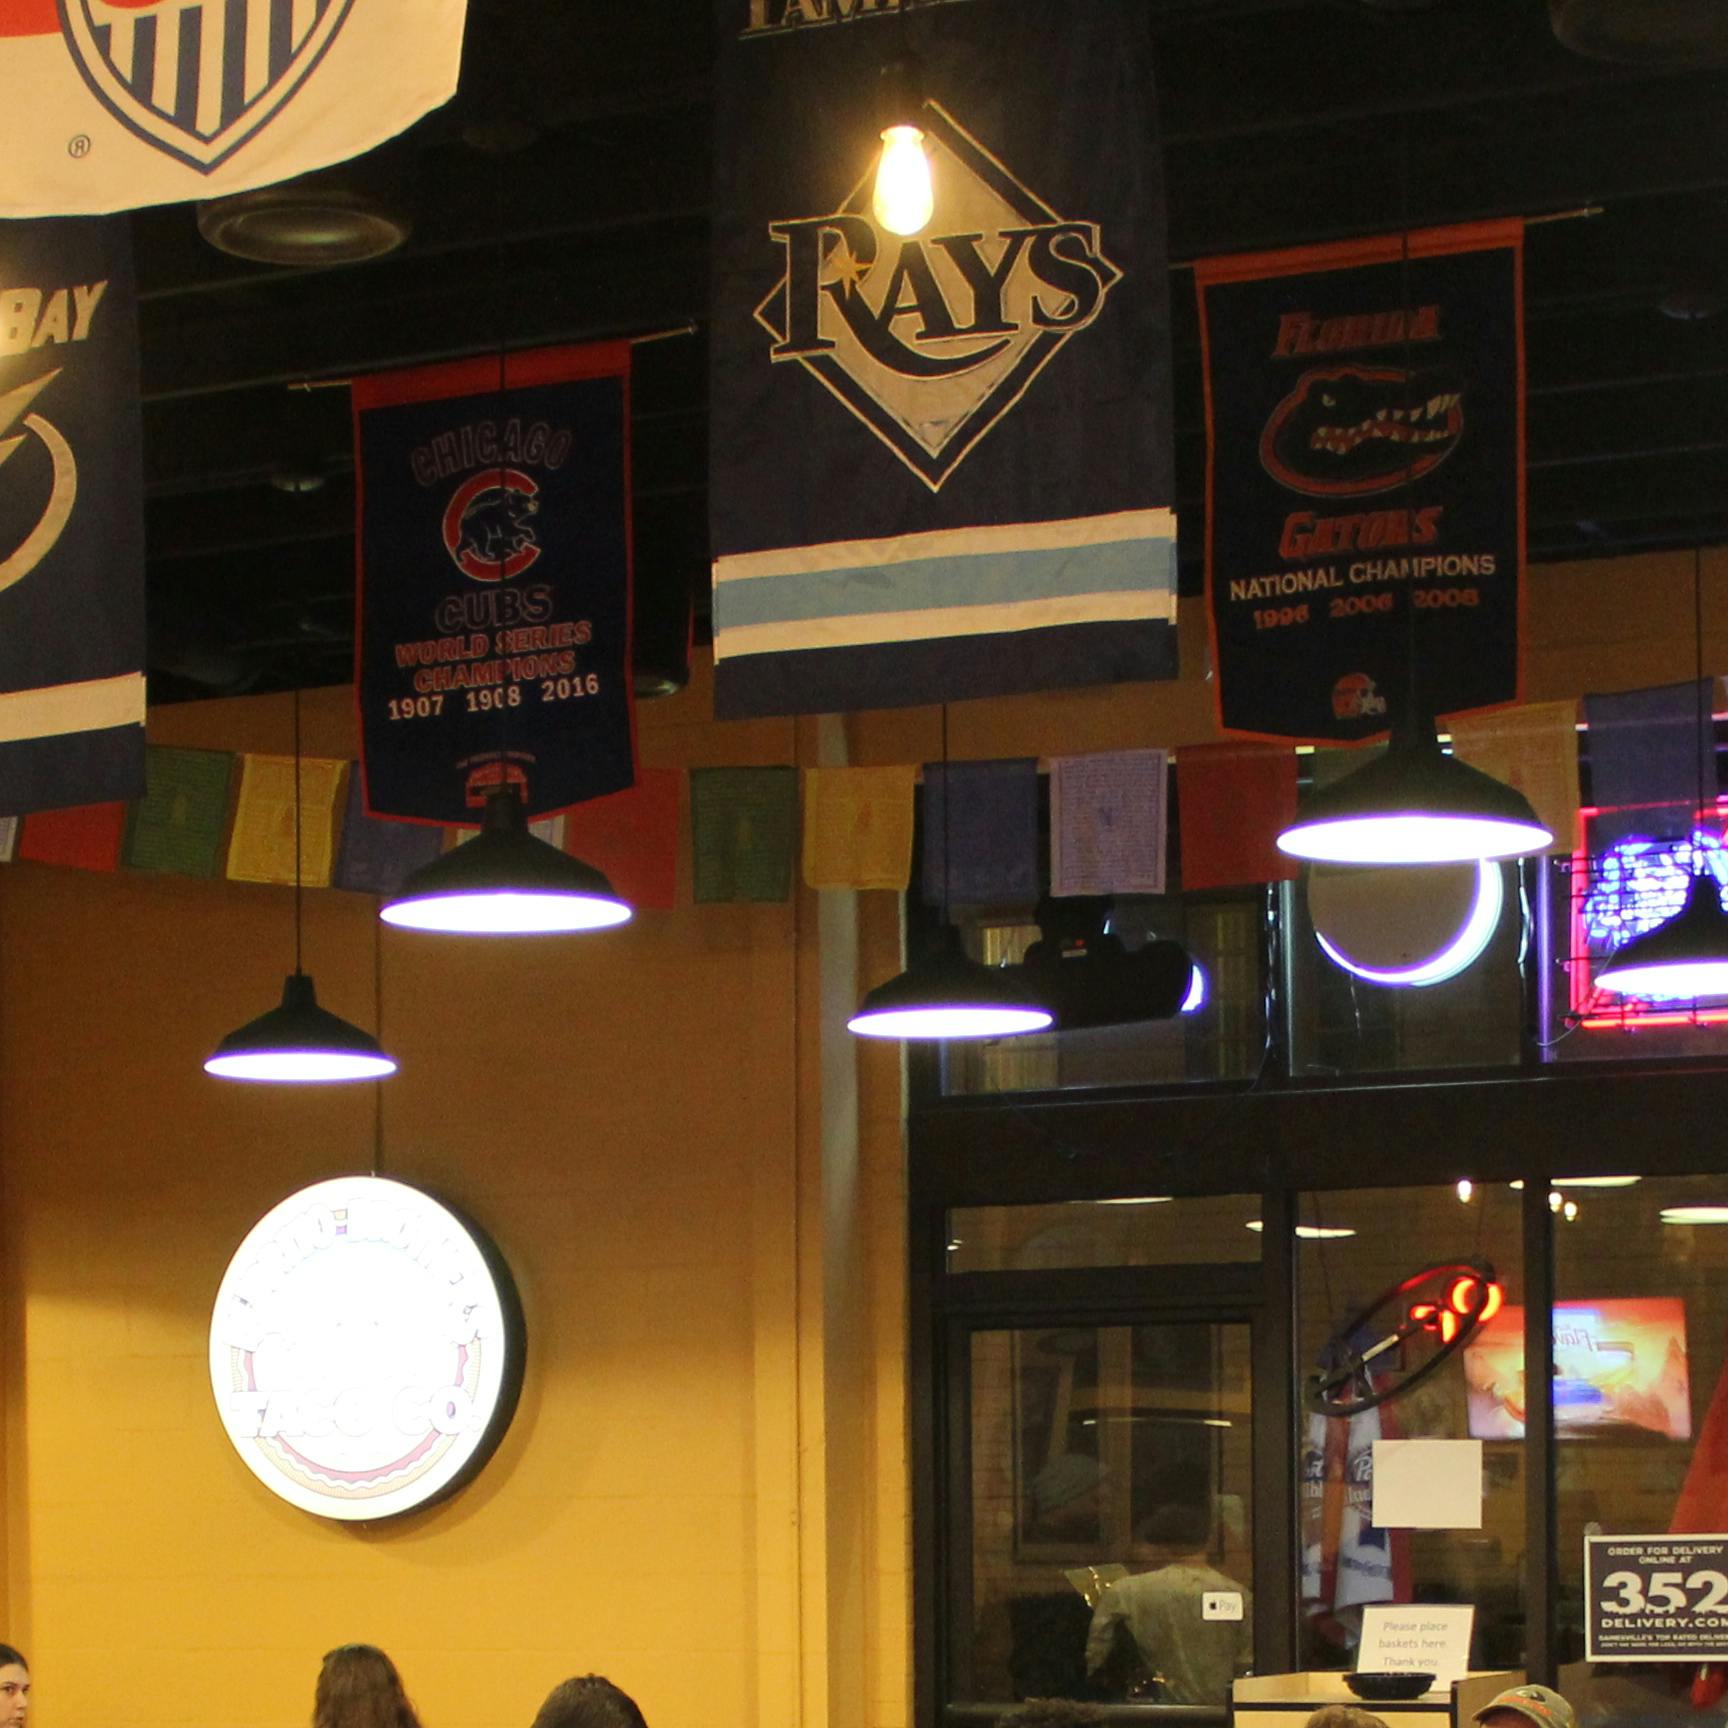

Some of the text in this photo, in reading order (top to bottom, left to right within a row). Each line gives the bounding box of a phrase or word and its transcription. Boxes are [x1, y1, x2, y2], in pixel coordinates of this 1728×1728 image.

[769, 213, 1103, 382] RAYS
[1269, 304, 1442, 361] FLORIDA
[410, 416, 573, 488] CHICAGO
[1277, 505, 1444, 561] GATORS
[1228, 554, 1497, 602] NATIONAL CHAMPIONS
[434, 583, 554, 635] CUBS
[1252, 586, 1480, 631] 1996 2006 2008
[394, 619, 593, 668] WORLD SERIES
[414, 650, 577, 694] CHAMPIONS
[387, 672, 600, 722] 1907 1908 2016
[1607, 1544, 1724, 1556] ORDER FOR DELIVERY
[1638, 1555, 1693, 1565] ONLINE AT
[1218, 1600, 1236, 1613] Pay
[1383, 1620, 1449, 1633] Please place
[1378, 1638, 1419, 1649] baskets
[1384, 1656, 1416, 1667] Thank
